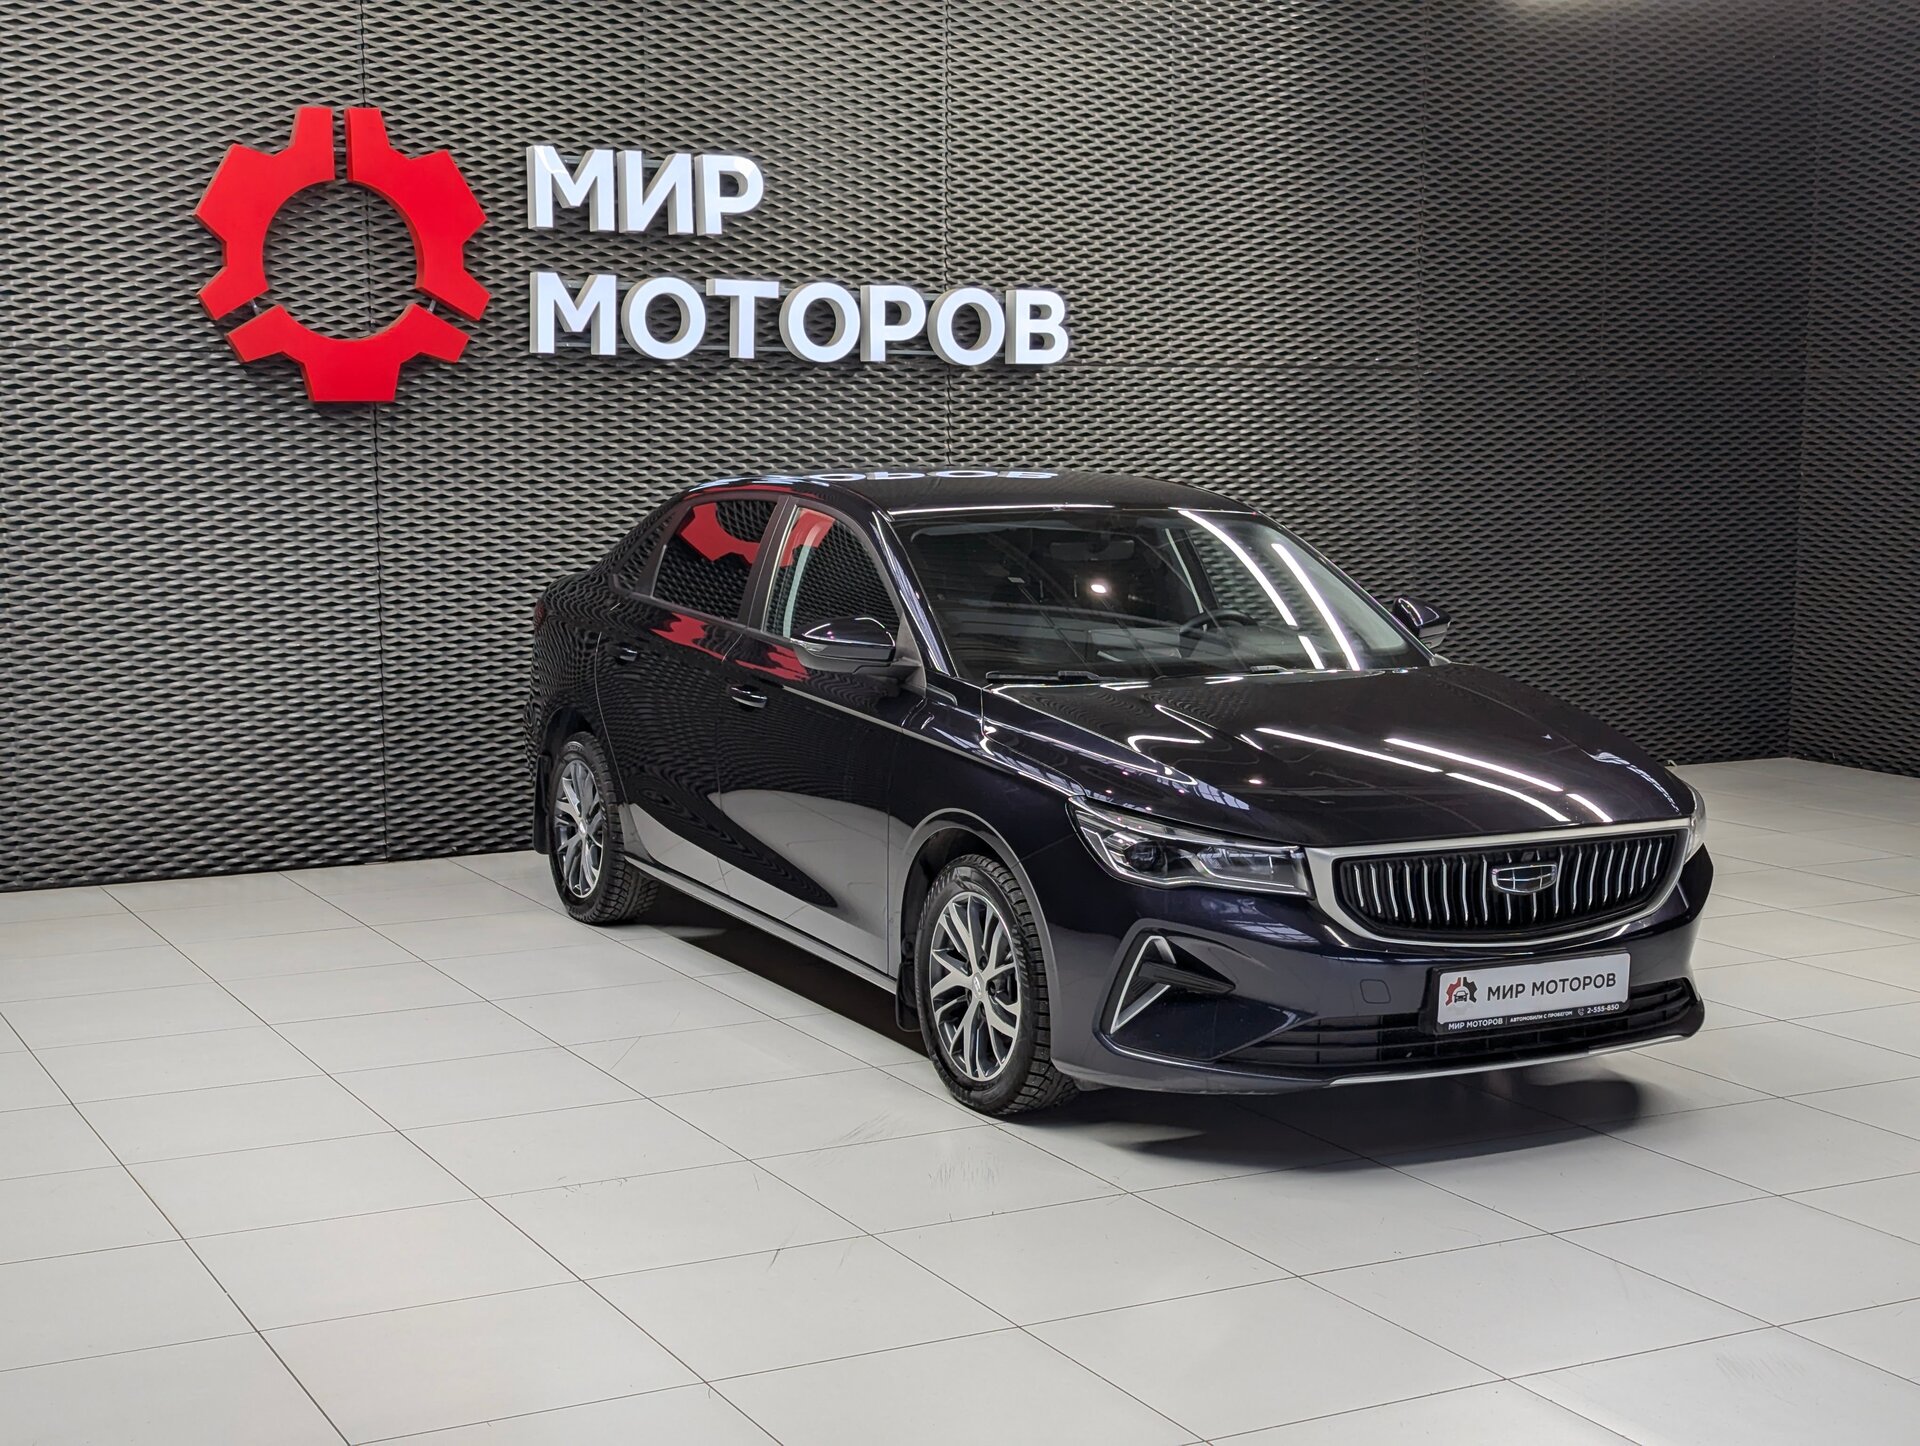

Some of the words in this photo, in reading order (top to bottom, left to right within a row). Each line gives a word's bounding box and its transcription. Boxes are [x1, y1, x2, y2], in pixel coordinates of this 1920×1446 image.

[526, 144, 764, 236] МИР
[529, 271, 1070, 366] МОТОРОВ
[1487, 983, 1525, 1002] МИР
[1531, 973, 1616, 997] МОТОРОВ
[1448, 1022, 1465, 1030] МИР
[1466, 1018, 1503, 1028] МОТОРОВ
[1510, 1014, 1543, 1023] АВТОМОБИЛИ
[1547, 1010, 1573, 1018] ПРОБЕГОМ
